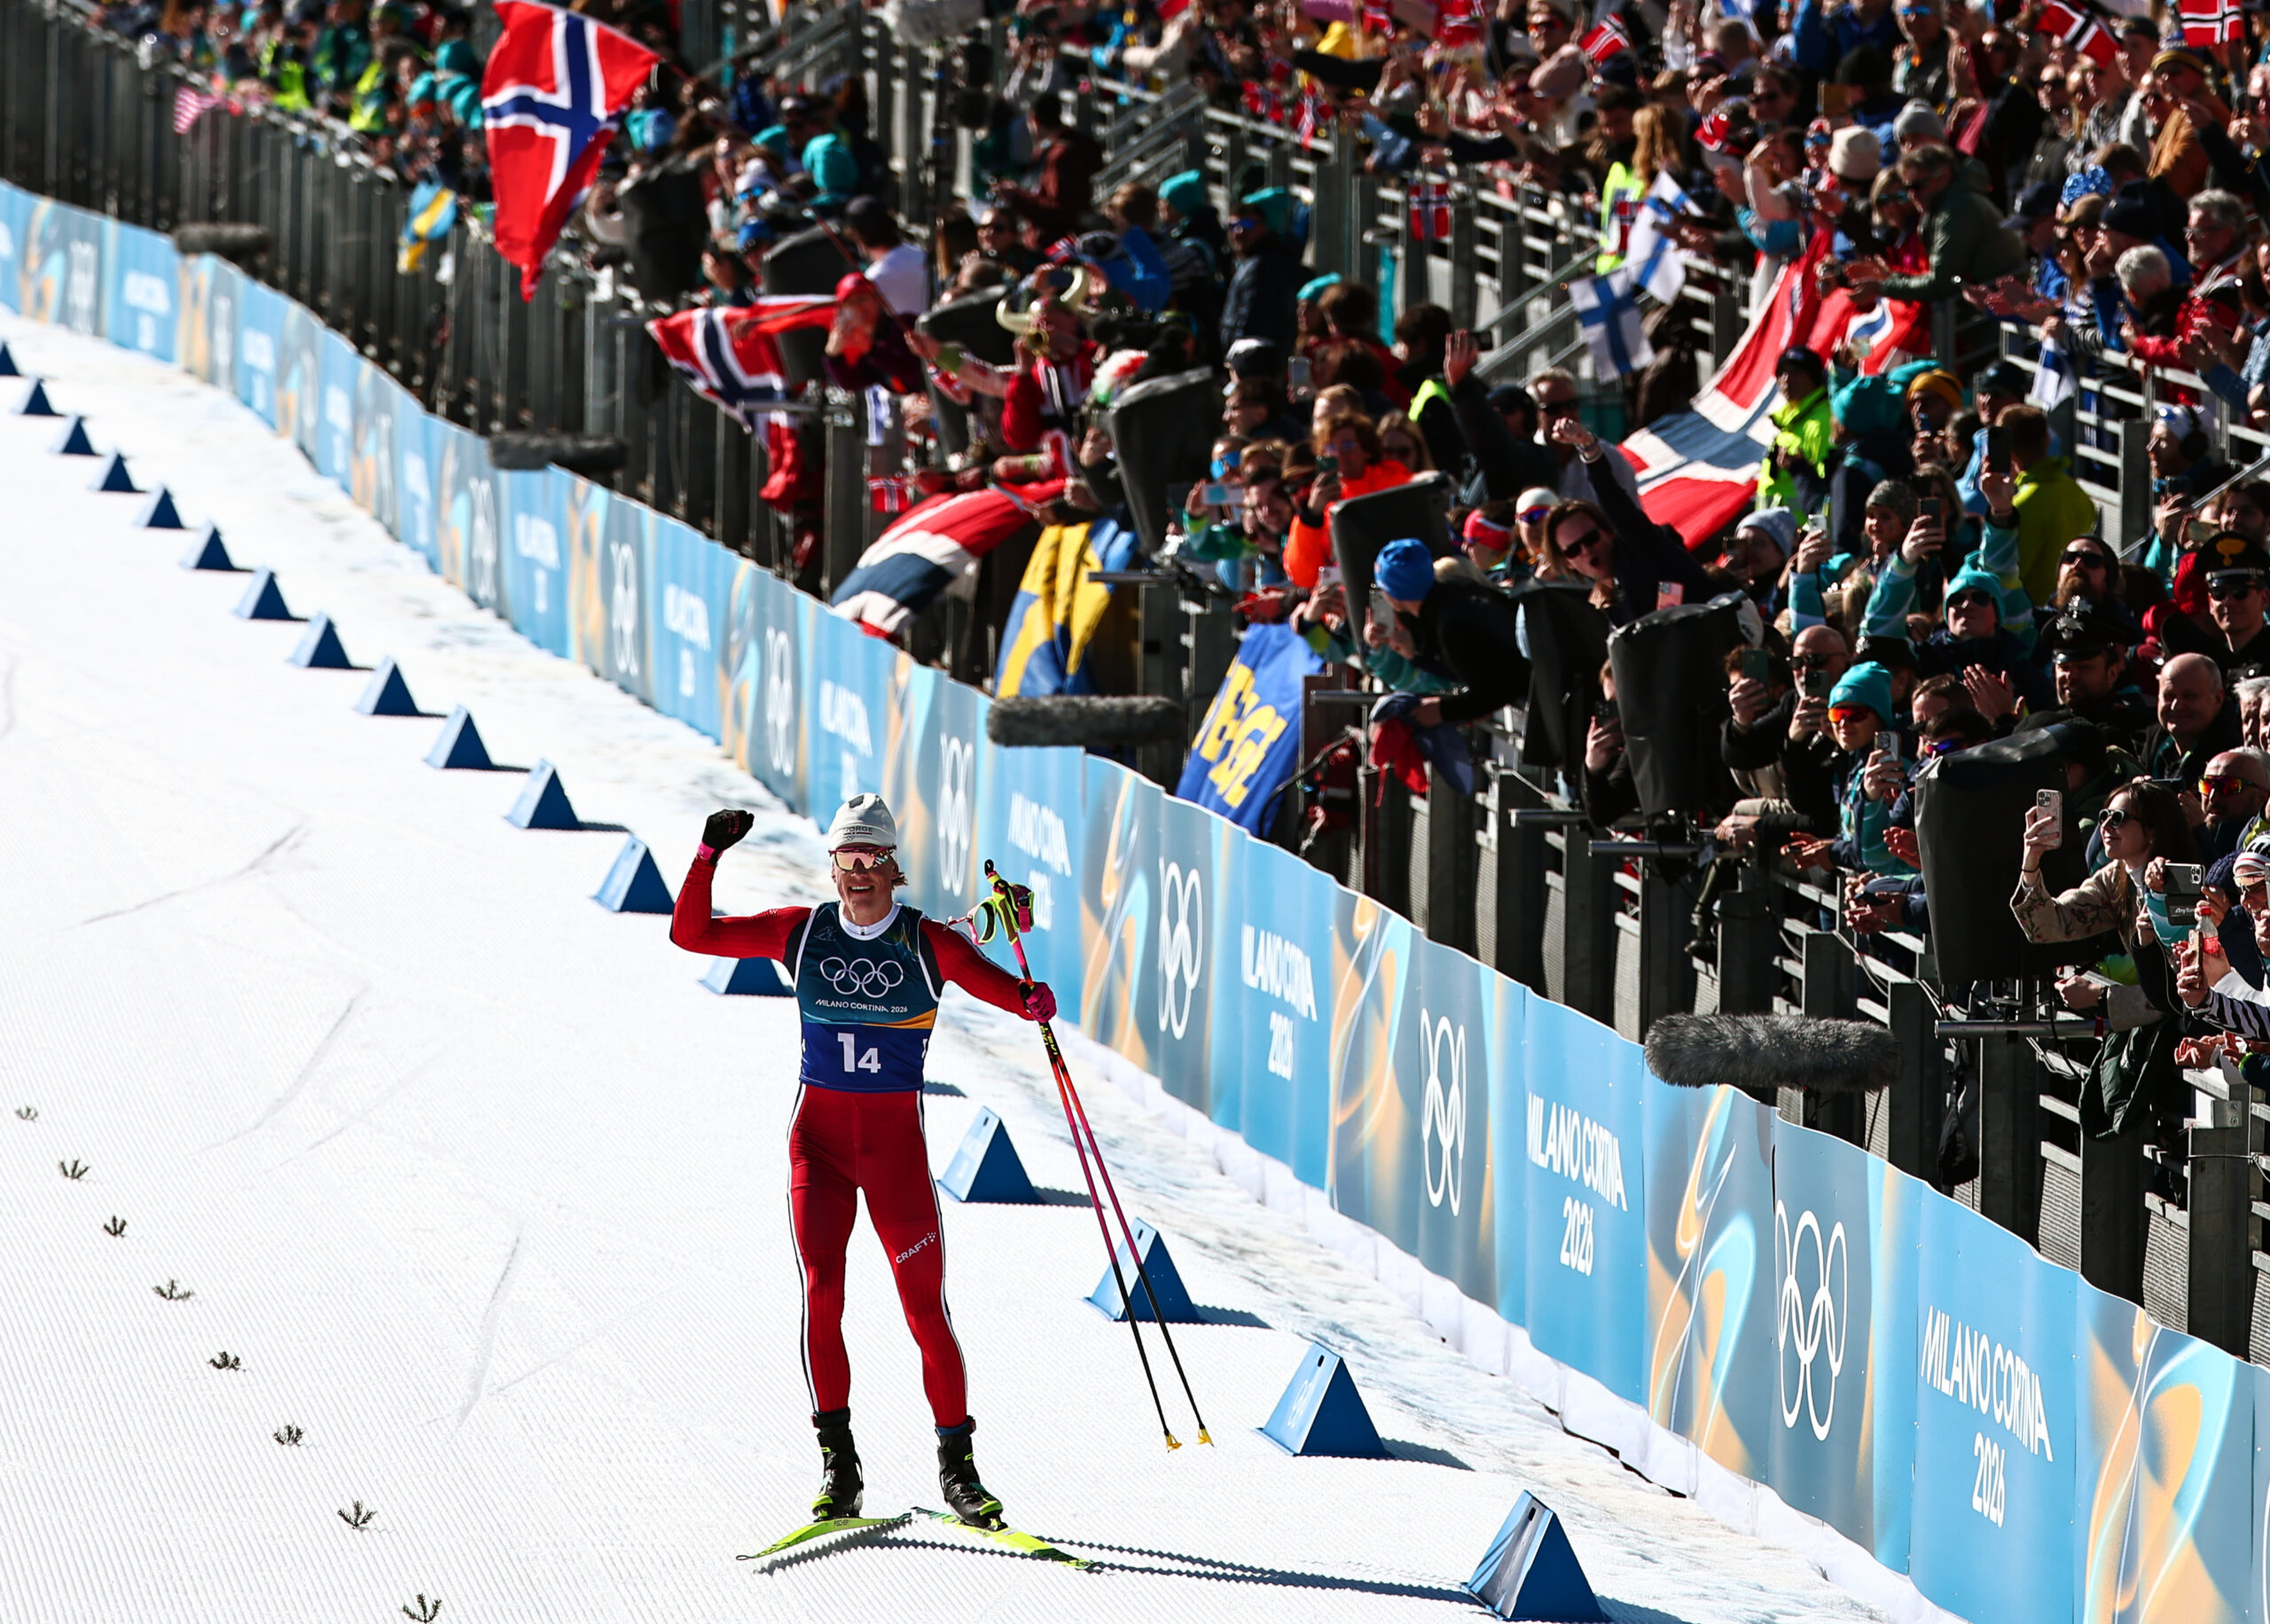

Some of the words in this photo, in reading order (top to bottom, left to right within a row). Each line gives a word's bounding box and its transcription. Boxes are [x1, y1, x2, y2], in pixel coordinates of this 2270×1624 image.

[816, 999, 849, 1008] MILANO
[850, 1002, 888, 1012] CORTINA
[837, 1032, 881, 1074] 14
[1526, 1092, 1581, 1182] MILANO
[896, 1238, 928, 1264] CRAFT
[1560, 1196, 1594, 1277] 2026
[1921, 1305, 1991, 1415] MILANO
[1992, 1342, 2054, 1463] CORTINA
[1972, 1432, 2006, 1528] 2026
